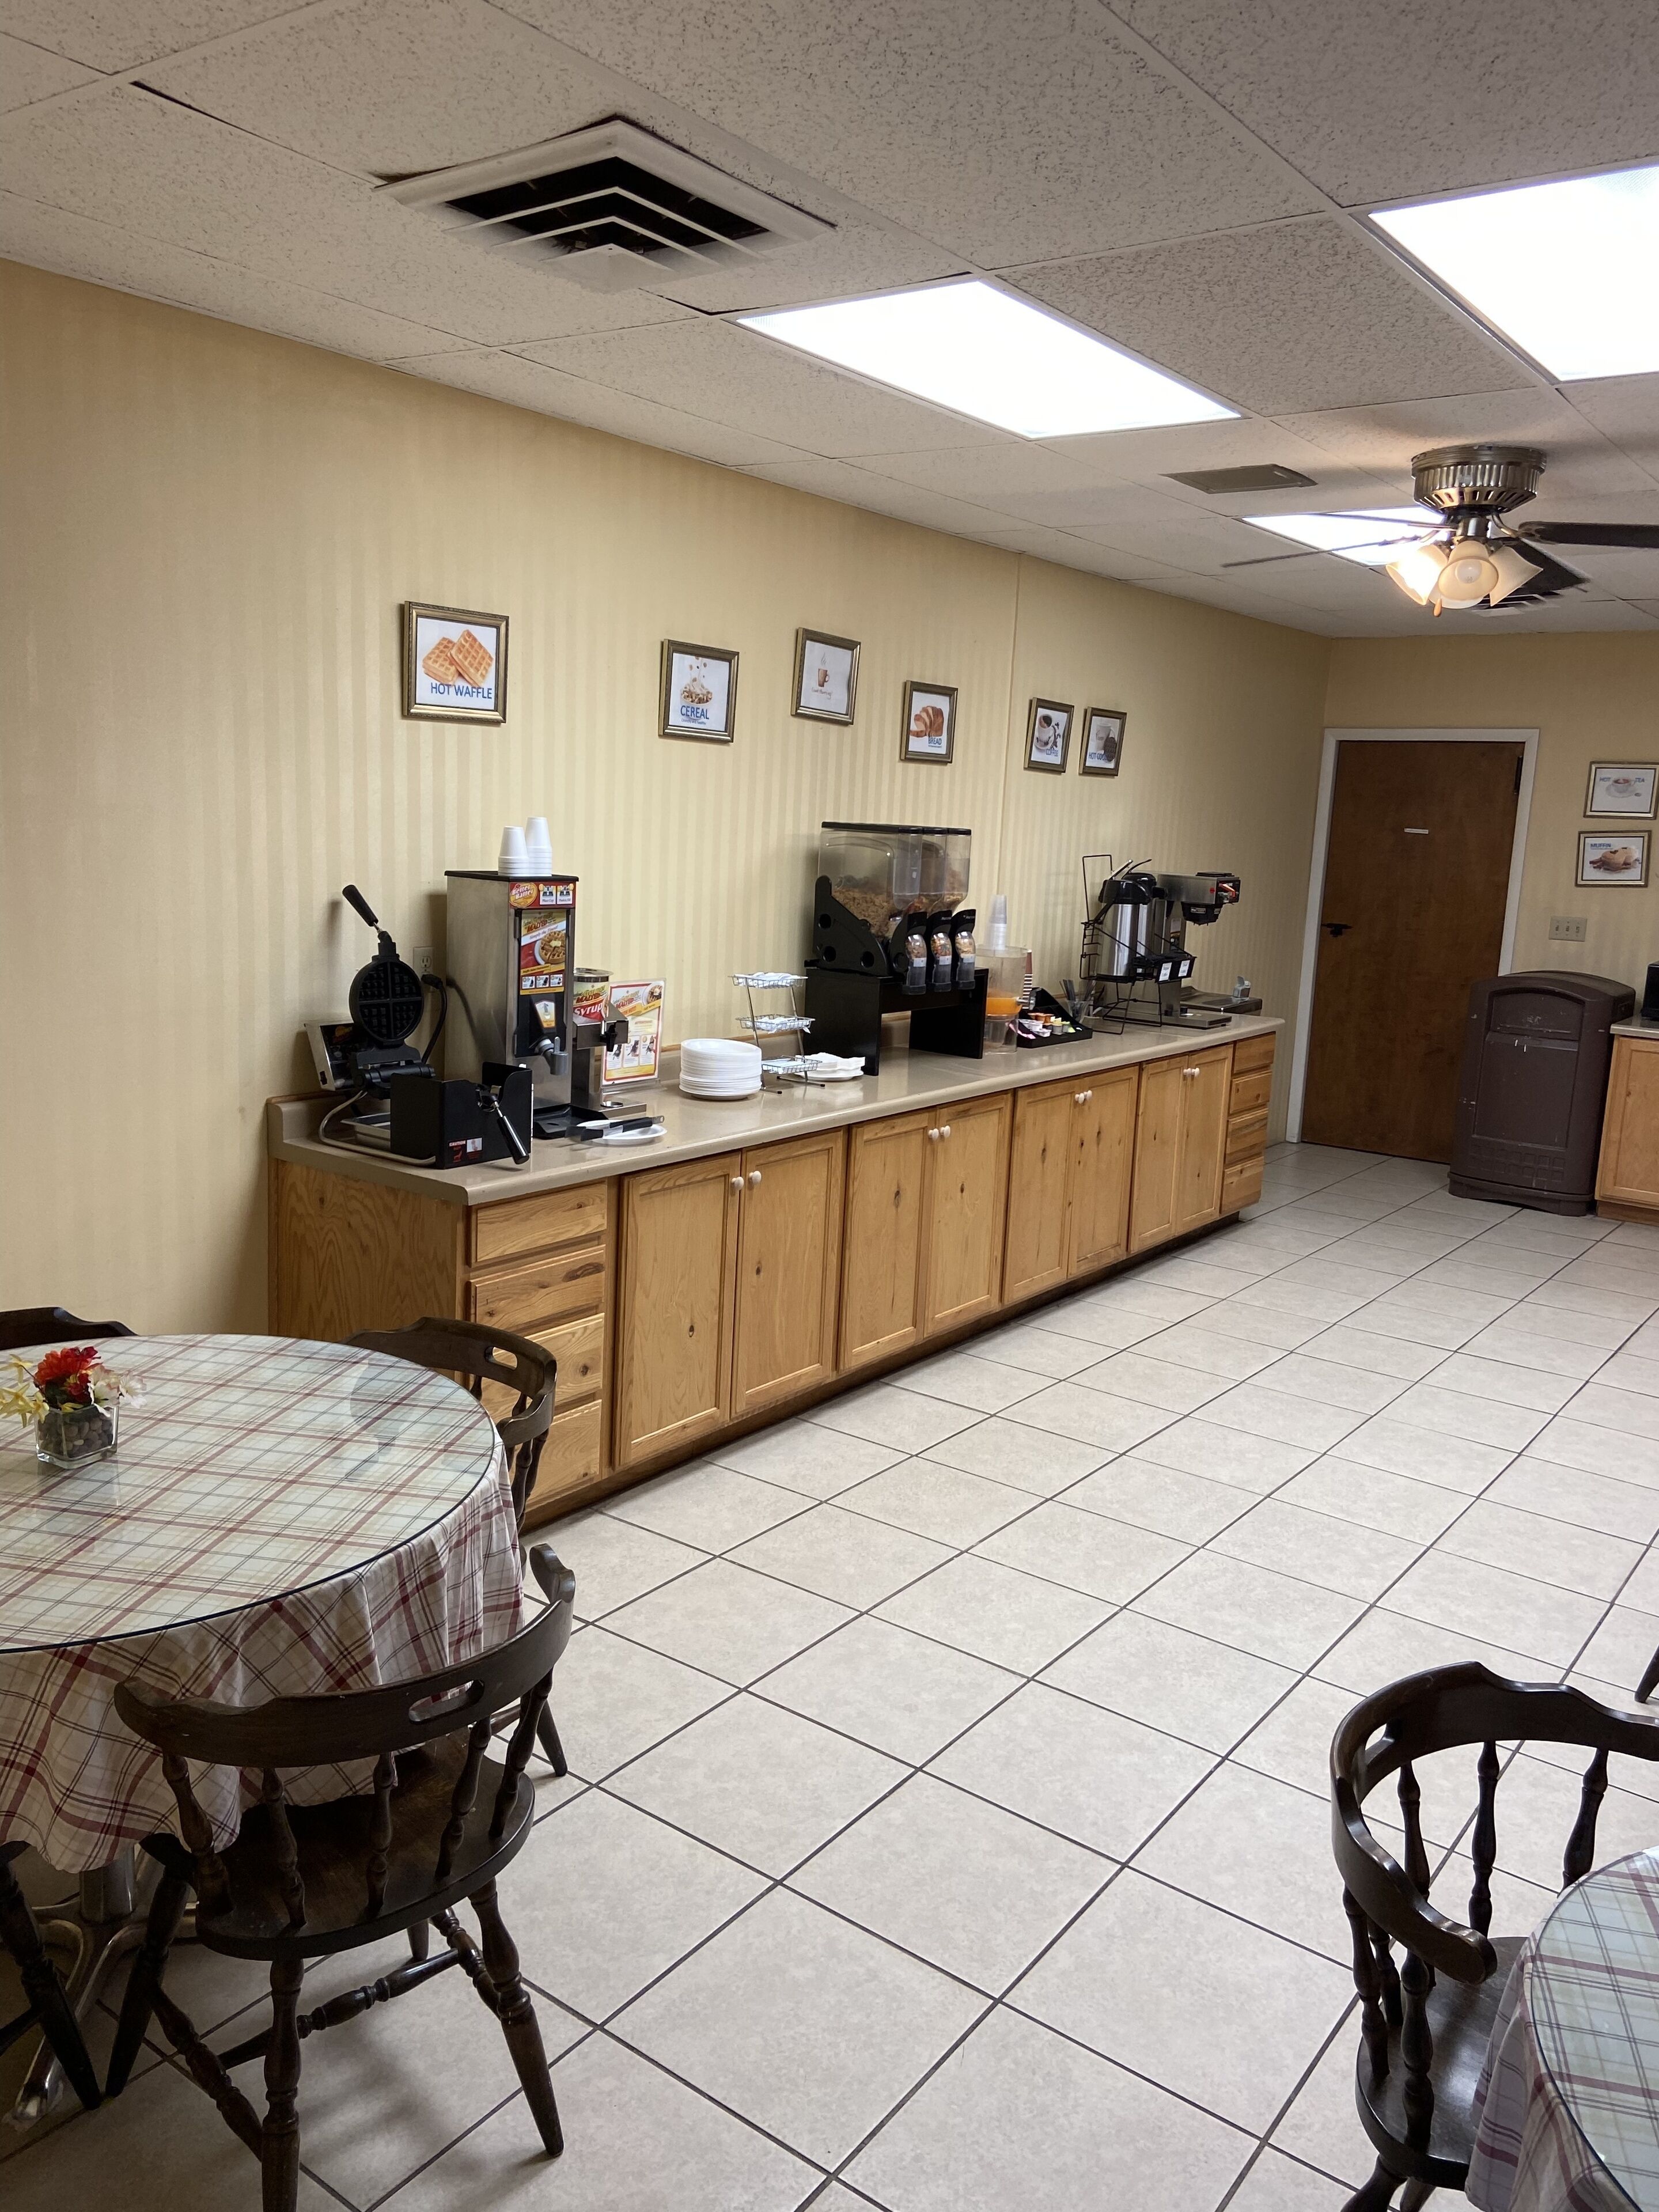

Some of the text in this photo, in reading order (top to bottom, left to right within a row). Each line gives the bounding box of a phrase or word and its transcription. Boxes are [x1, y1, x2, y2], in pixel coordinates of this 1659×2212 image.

[431, 682, 493, 699] HOT WAFFLE
[680, 705, 710, 719] CEREAL
[928, 737, 942, 745] BREAD
[1046, 749, 1059, 757] COFFEE
[1097, 753, 1107, 761] COCO
[512, 884, 531, 896] Better
[574, 1002, 603, 1017] Syrup
